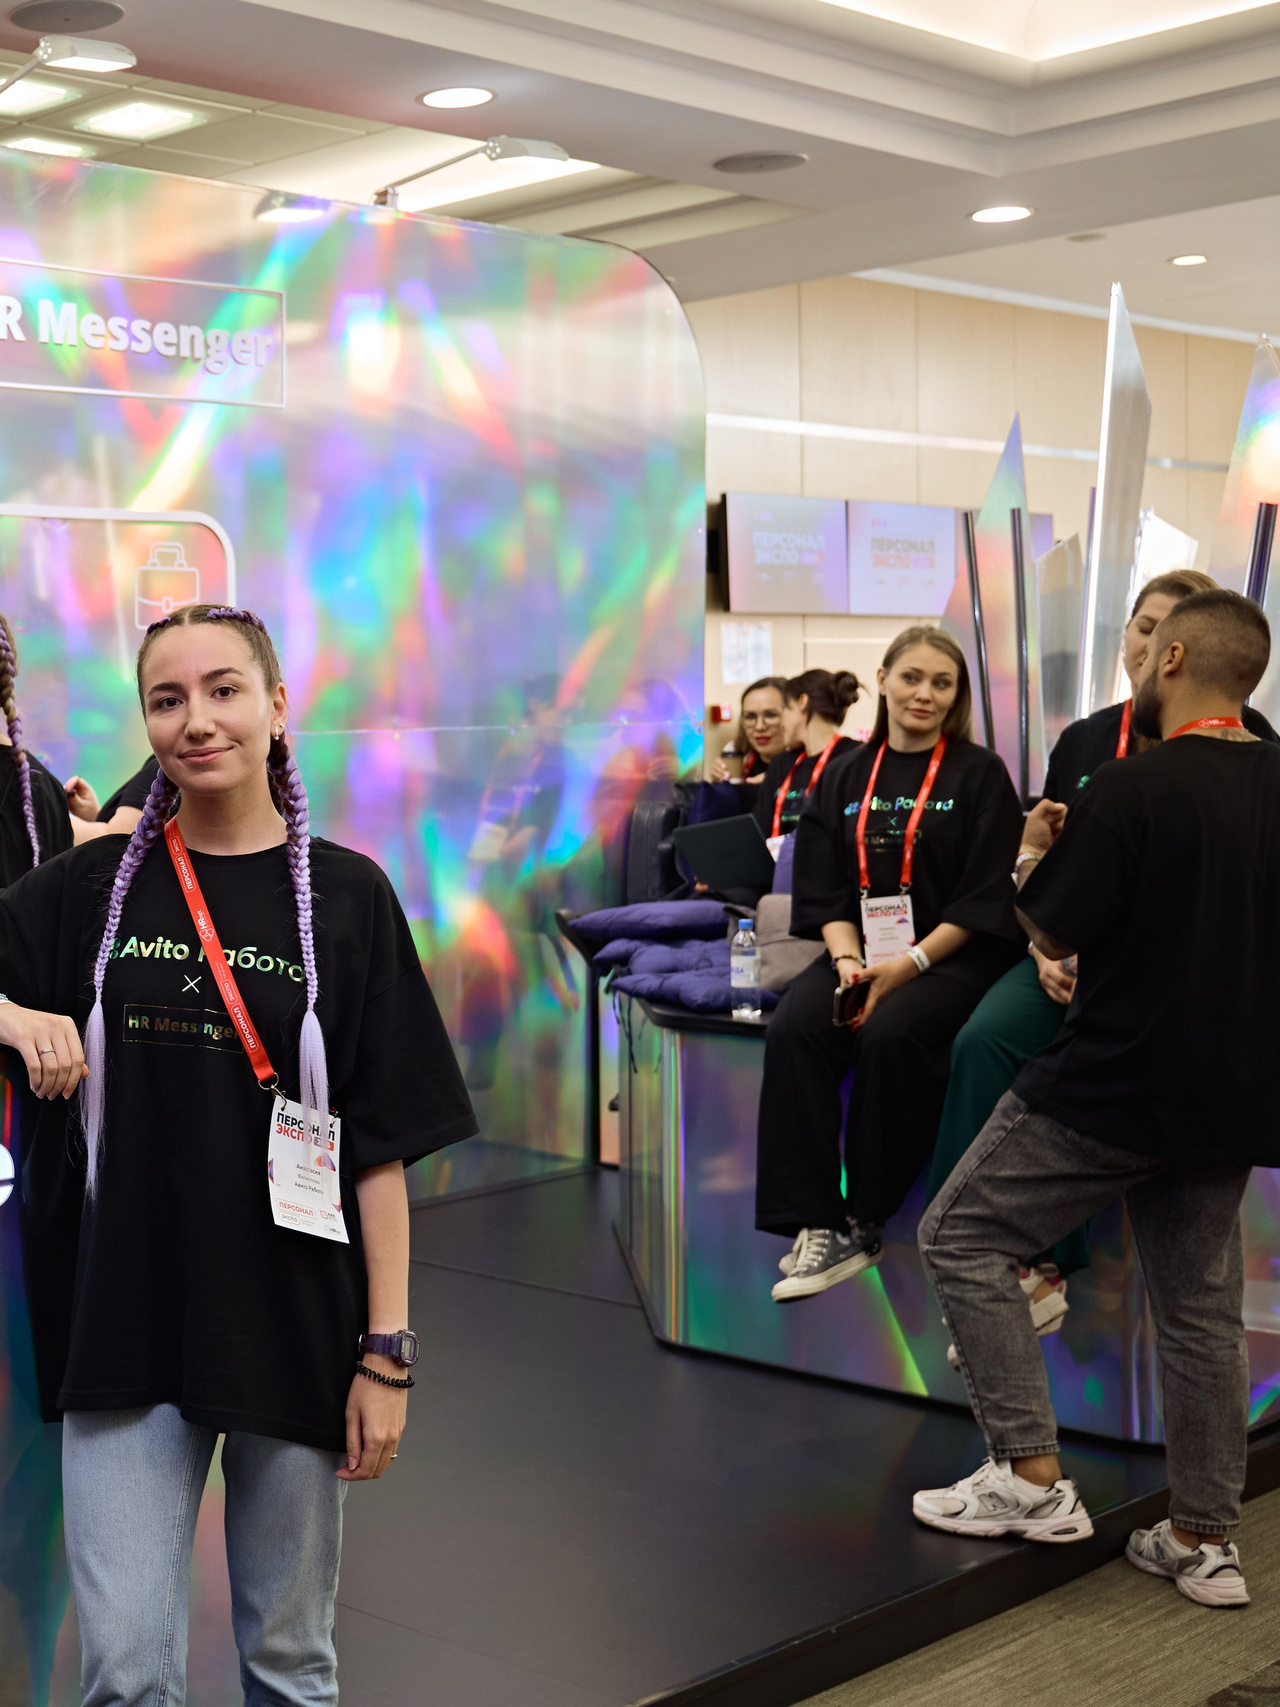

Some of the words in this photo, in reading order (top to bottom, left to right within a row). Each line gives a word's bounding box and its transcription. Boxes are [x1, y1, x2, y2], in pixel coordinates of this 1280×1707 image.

[38, 298, 273, 375] Messenger
[871, 538, 936, 554] ПЕРСОНАЛ
[177, 856, 194, 889] ПЕРСОНАЛ
[120, 936, 189, 960] Avito
[128, 1014, 150, 1030] HR
[233, 1007, 256, 1049] ПЕРСОНАЛ
[276, 1111, 336, 1142] ПЕРСНЛ
[279, 1201, 314, 1217] ПЕРСОНАЛ
